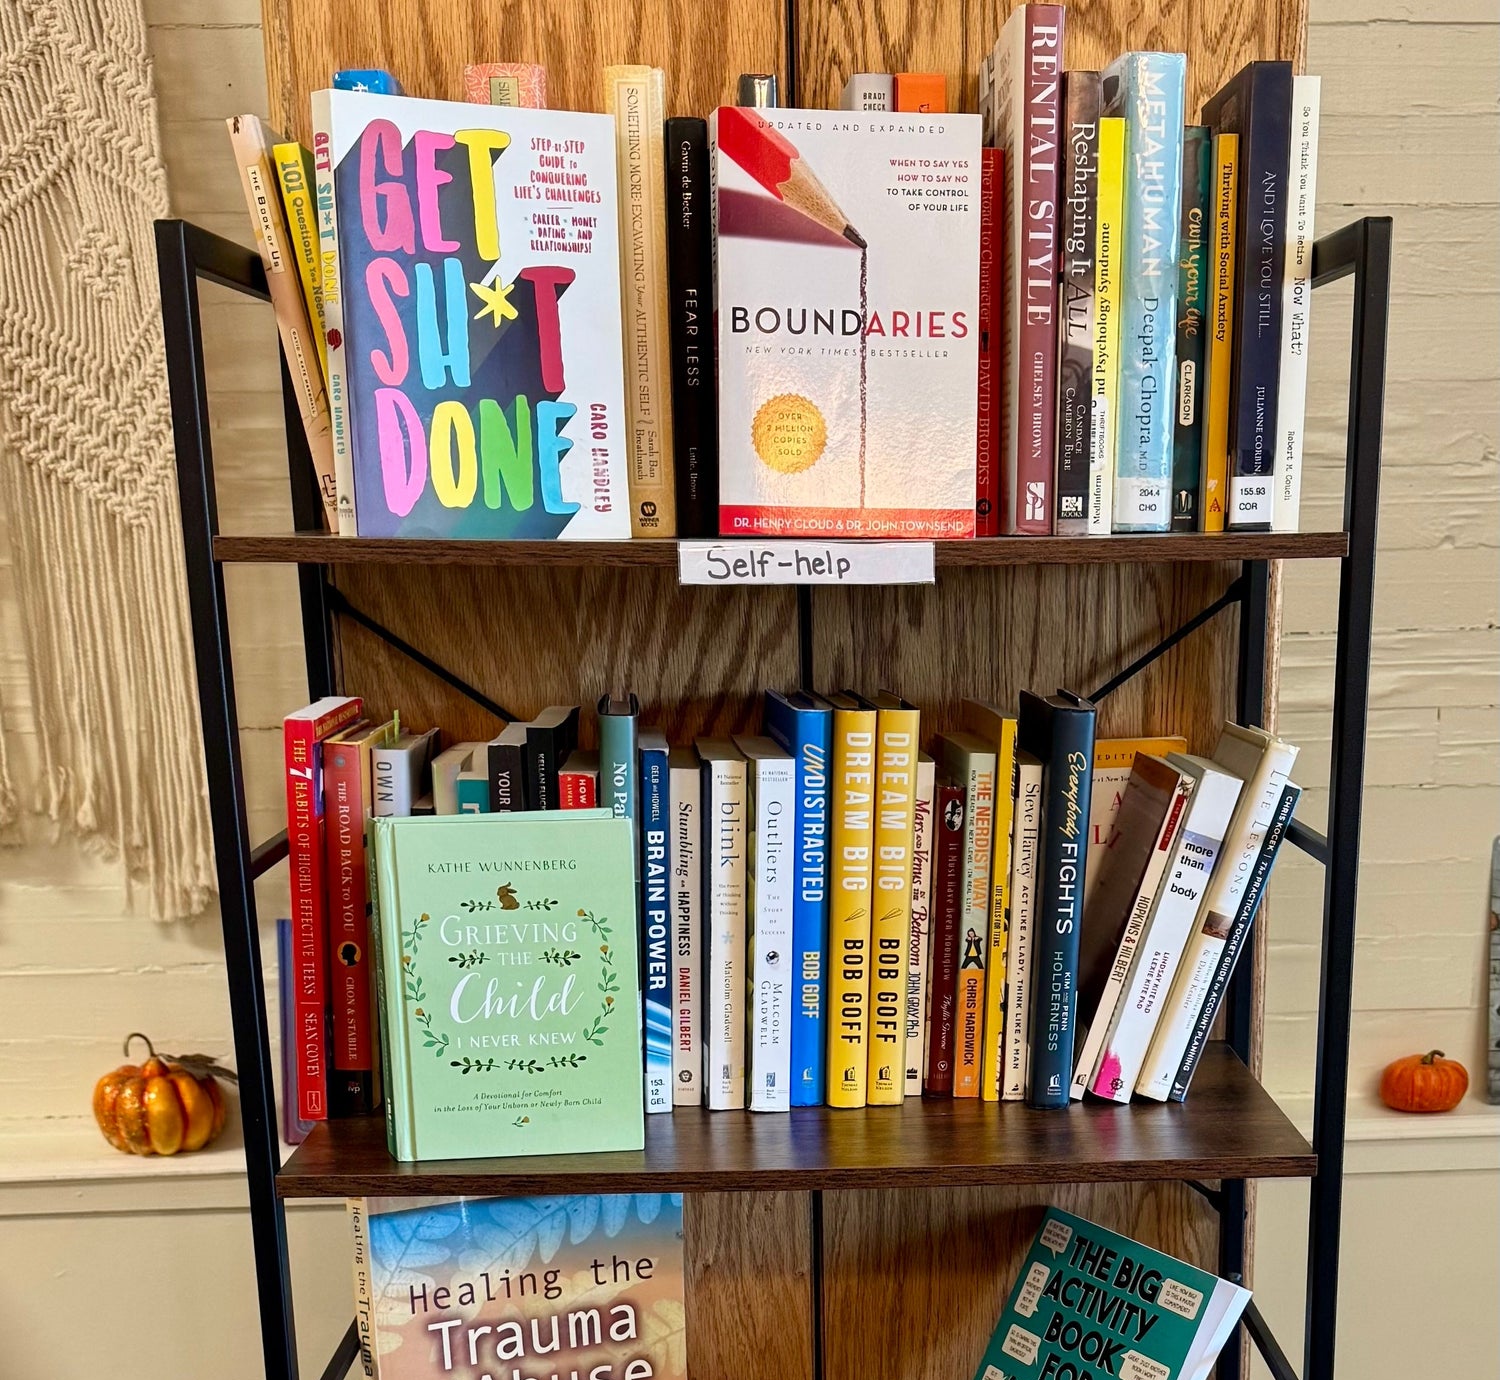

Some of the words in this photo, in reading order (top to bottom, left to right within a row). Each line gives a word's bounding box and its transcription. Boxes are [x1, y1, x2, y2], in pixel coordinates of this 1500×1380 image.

[1029, 22, 1059, 184] RENTAL
[360, 119, 511, 260] GET
[514, 185, 540, 199] LIFE'S
[545, 188, 601, 203] CHALLENGES
[530, 170, 587, 186] CONQUERING
[887, 188, 897, 196] TO
[901, 188, 922, 196] TAKE
[926, 189, 968, 197] CONTROL
[1068, 122, 1097, 254] Reshaping
[1140, 72, 1166, 276] METAHUMAN
[1222, 162, 1232, 217] Thriving
[281, 160, 302, 188] 101
[292, 196, 314, 262] Questions
[908, 203, 920, 211] OF
[923, 203, 948, 212] YOUR
[949, 204, 969, 212] LIFE
[531, 240, 591, 253] RELATIONSHIPS!
[1222, 220, 1231, 249] with
[1028, 199, 1053, 326] STYLE
[1067, 260, 1089, 275] It
[1220, 252, 1230, 291] Social
[686, 289, 697, 336] FEAR
[1067, 281, 1090, 337] ALL
[1294, 277, 1305, 306] Now
[731, 307, 968, 338] BOUNDARIES
[1142, 296, 1160, 361] Deepak
[1216, 294, 1231, 342] Anxiety
[1291, 312, 1303, 355] What?
[688, 346, 699, 386] LESS
[1032, 351, 1044, 408] CHELSEY
[1182, 364, 1191, 421] CLARKSON
[590, 403, 607, 441] CARO
[1031, 408, 1043, 459] BROWN
[374, 388, 581, 517] DONE
[592, 446, 612, 513] HANDLEY
[1140, 488, 1160, 497] 204.4
[1240, 487, 1266, 497] 155.93
[734, 518, 749, 528] DR.
[753, 518, 790, 530] HENRY
[794, 519, 832, 530] CLOUD
[835, 520, 843, 530] &
[846, 520, 861, 530] DR.
[864, 521, 897, 531] JOHN
[900, 521, 964, 531] TOWNSEND
[1139, 502, 1157, 511] CHO
[1239, 502, 1258, 511] COR
[707, 549, 851, 579] Self-help
[844, 732, 872, 831] DREAM
[880, 732, 909, 831] DREAM
[1059, 752, 1086, 841] Everybody
[721, 801, 739, 868] blink
[766, 800, 782, 884] Outliers
[802, 743, 825, 902] UNDISTRACTED
[428, 858, 471, 873] KATHE
[479, 858, 577, 872] WUNNENBERG
[647, 830, 664, 902] BRAIN
[843, 846, 868, 891] BIG
[880, 846, 905, 891] BIG
[1181, 855, 1204, 870] than
[1185, 842, 1213, 857] more
[1056, 843, 1078, 934] FIGHTS
[1170, 884, 1197, 901] body
[677, 891, 690, 956] HAPPINESS
[498, 952, 532, 966] THE
[648, 908, 666, 991] POWER
[803, 951, 820, 982] BOB
[843, 939, 864, 980] BOB
[878, 938, 900, 980] BOB
[450, 973, 584, 1024] Child
[680, 967, 690, 1009] DANIEL
[801, 988, 819, 1019] GOFF
[1048, 951, 1063, 1051] HOLDERNESS
[680, 1014, 691, 1051] GILBERT
[760, 980, 771, 1047] GLADWELL
[771, 983, 782, 1045] MALCOLM
[841, 993, 861, 1044] GOFF
[876, 992, 897, 1044] GOFF
[470, 1034, 520, 1048] NEVER
[528, 1031, 576, 1046] KNEW
[408, 1268, 561, 1315] Healing
[590, 1256, 655, 1286] the
[1070, 1235, 1114, 1283] THE
[1114, 1258, 1163, 1304] BIG
[1044, 1270, 1160, 1343] ACTIVITY
[428, 1304, 638, 1370] Trauma
[1044, 1311, 1127, 1375] BOOK
